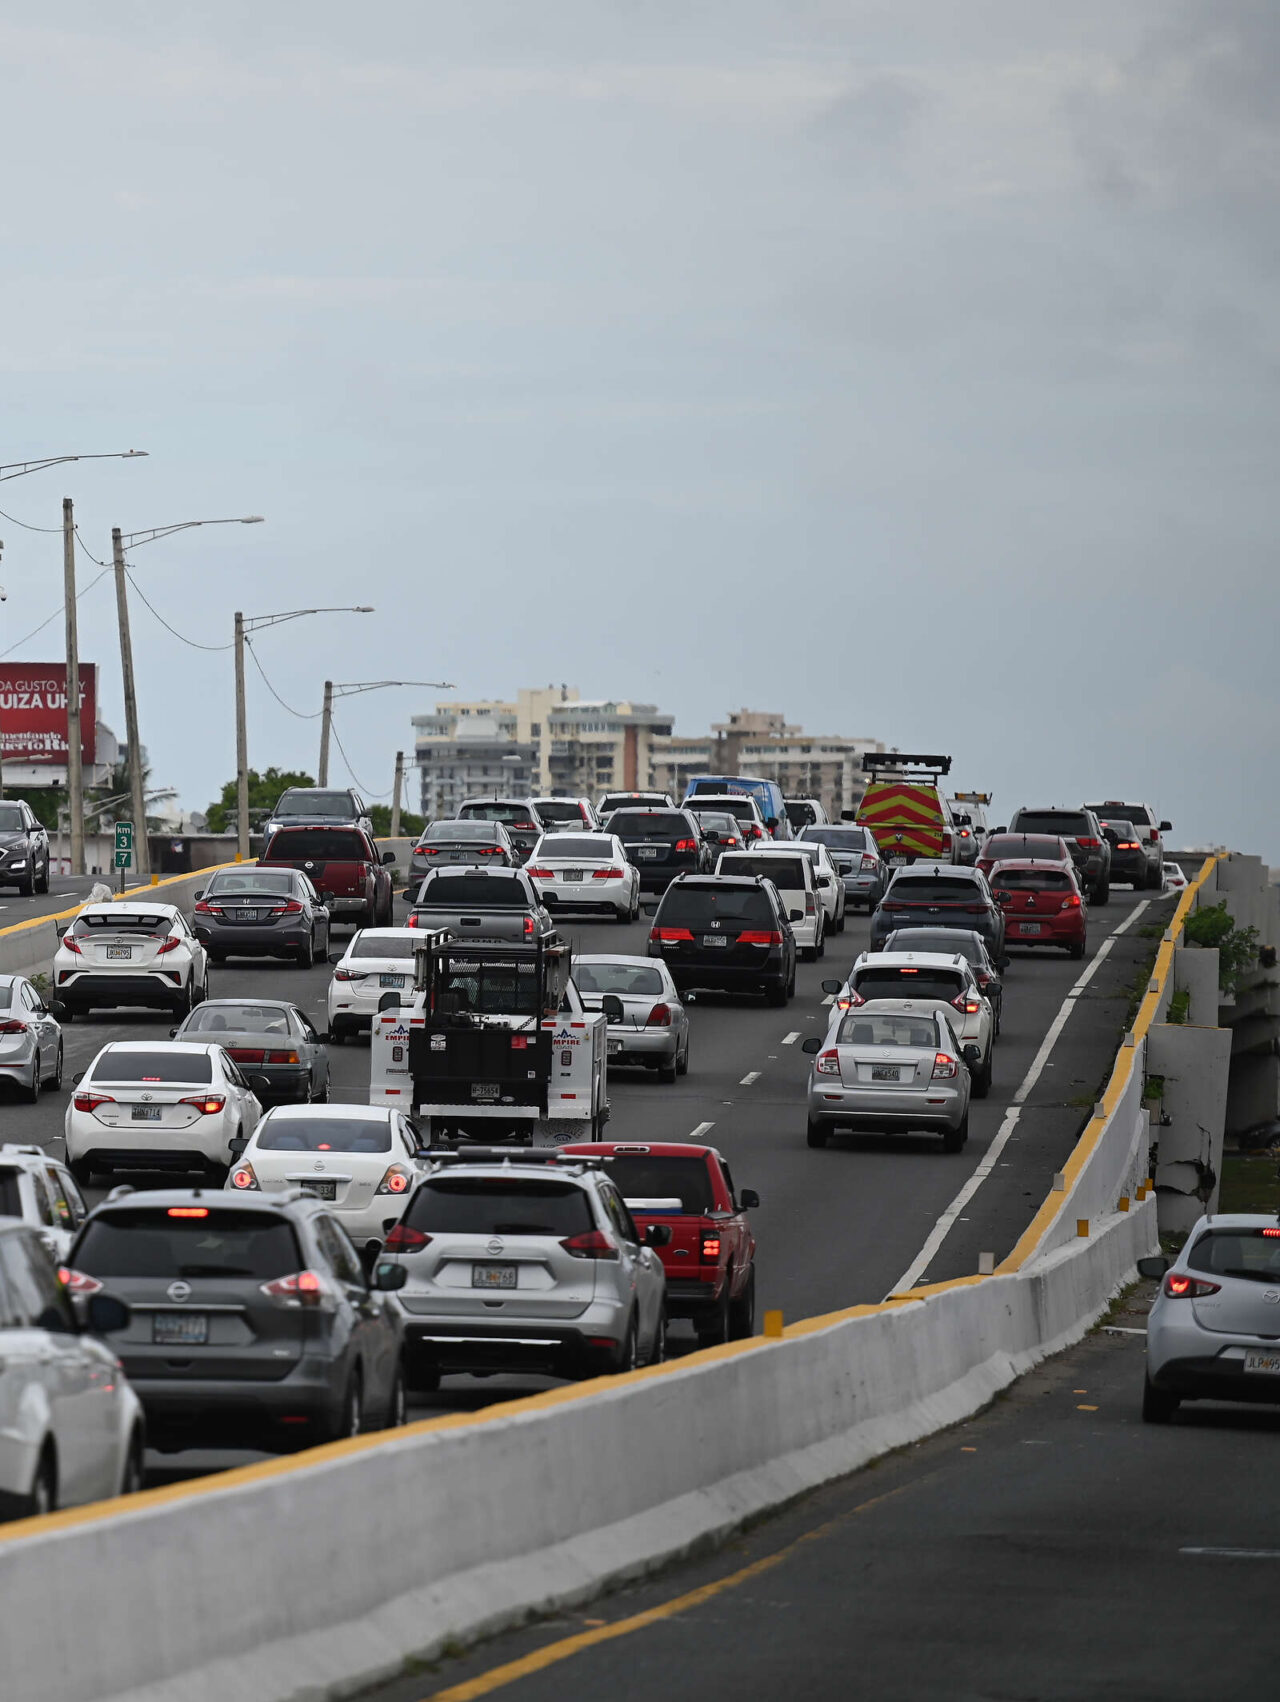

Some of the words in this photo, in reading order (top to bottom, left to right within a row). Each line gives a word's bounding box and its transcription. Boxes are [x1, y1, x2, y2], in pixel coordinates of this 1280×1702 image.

[16, 680, 59, 692] GUSTO,
[63, 680, 85, 691] HY
[0, 693, 44, 709] UIZA
[1, 732, 61, 740] mentando
[117, 826, 130, 834] km
[120, 836, 128, 847] 3
[320, 1184, 334, 1195] 334
